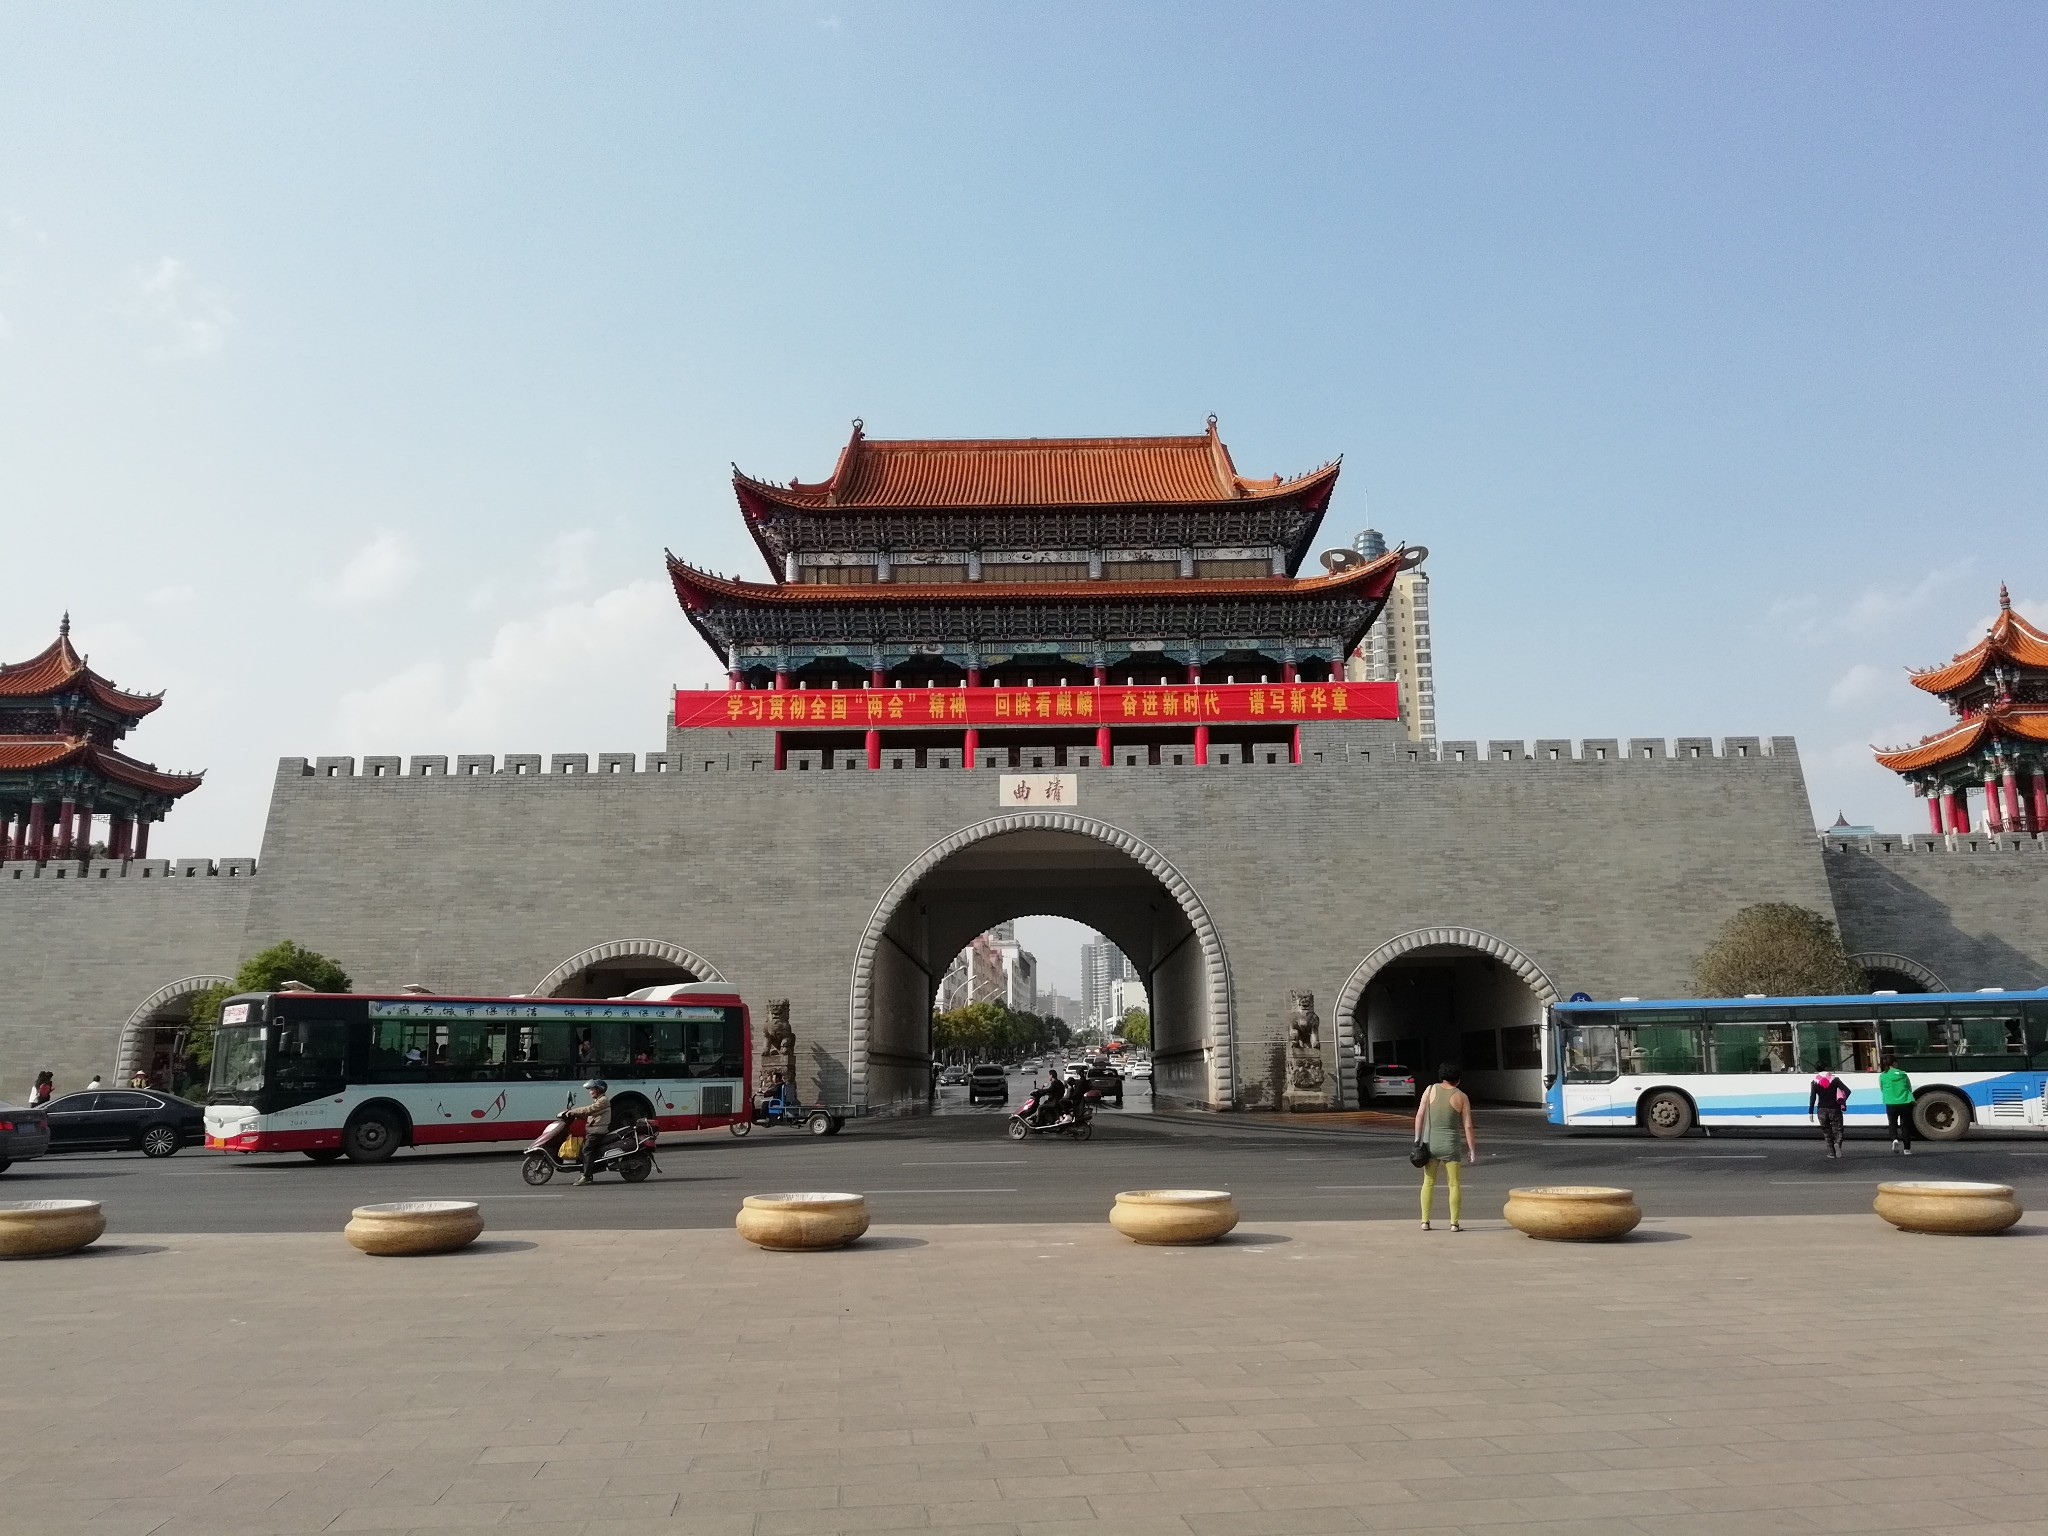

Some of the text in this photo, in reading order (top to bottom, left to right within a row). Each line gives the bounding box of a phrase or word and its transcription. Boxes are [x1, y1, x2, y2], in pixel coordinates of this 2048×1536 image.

[995, 690, 1093, 718] 回眸看麒麟
[1122, 689, 1220, 716] 奋进新时代
[1248, 687, 1348, 715] 谱写新华章
[1013, 779, 1064, 802] 曲靖
